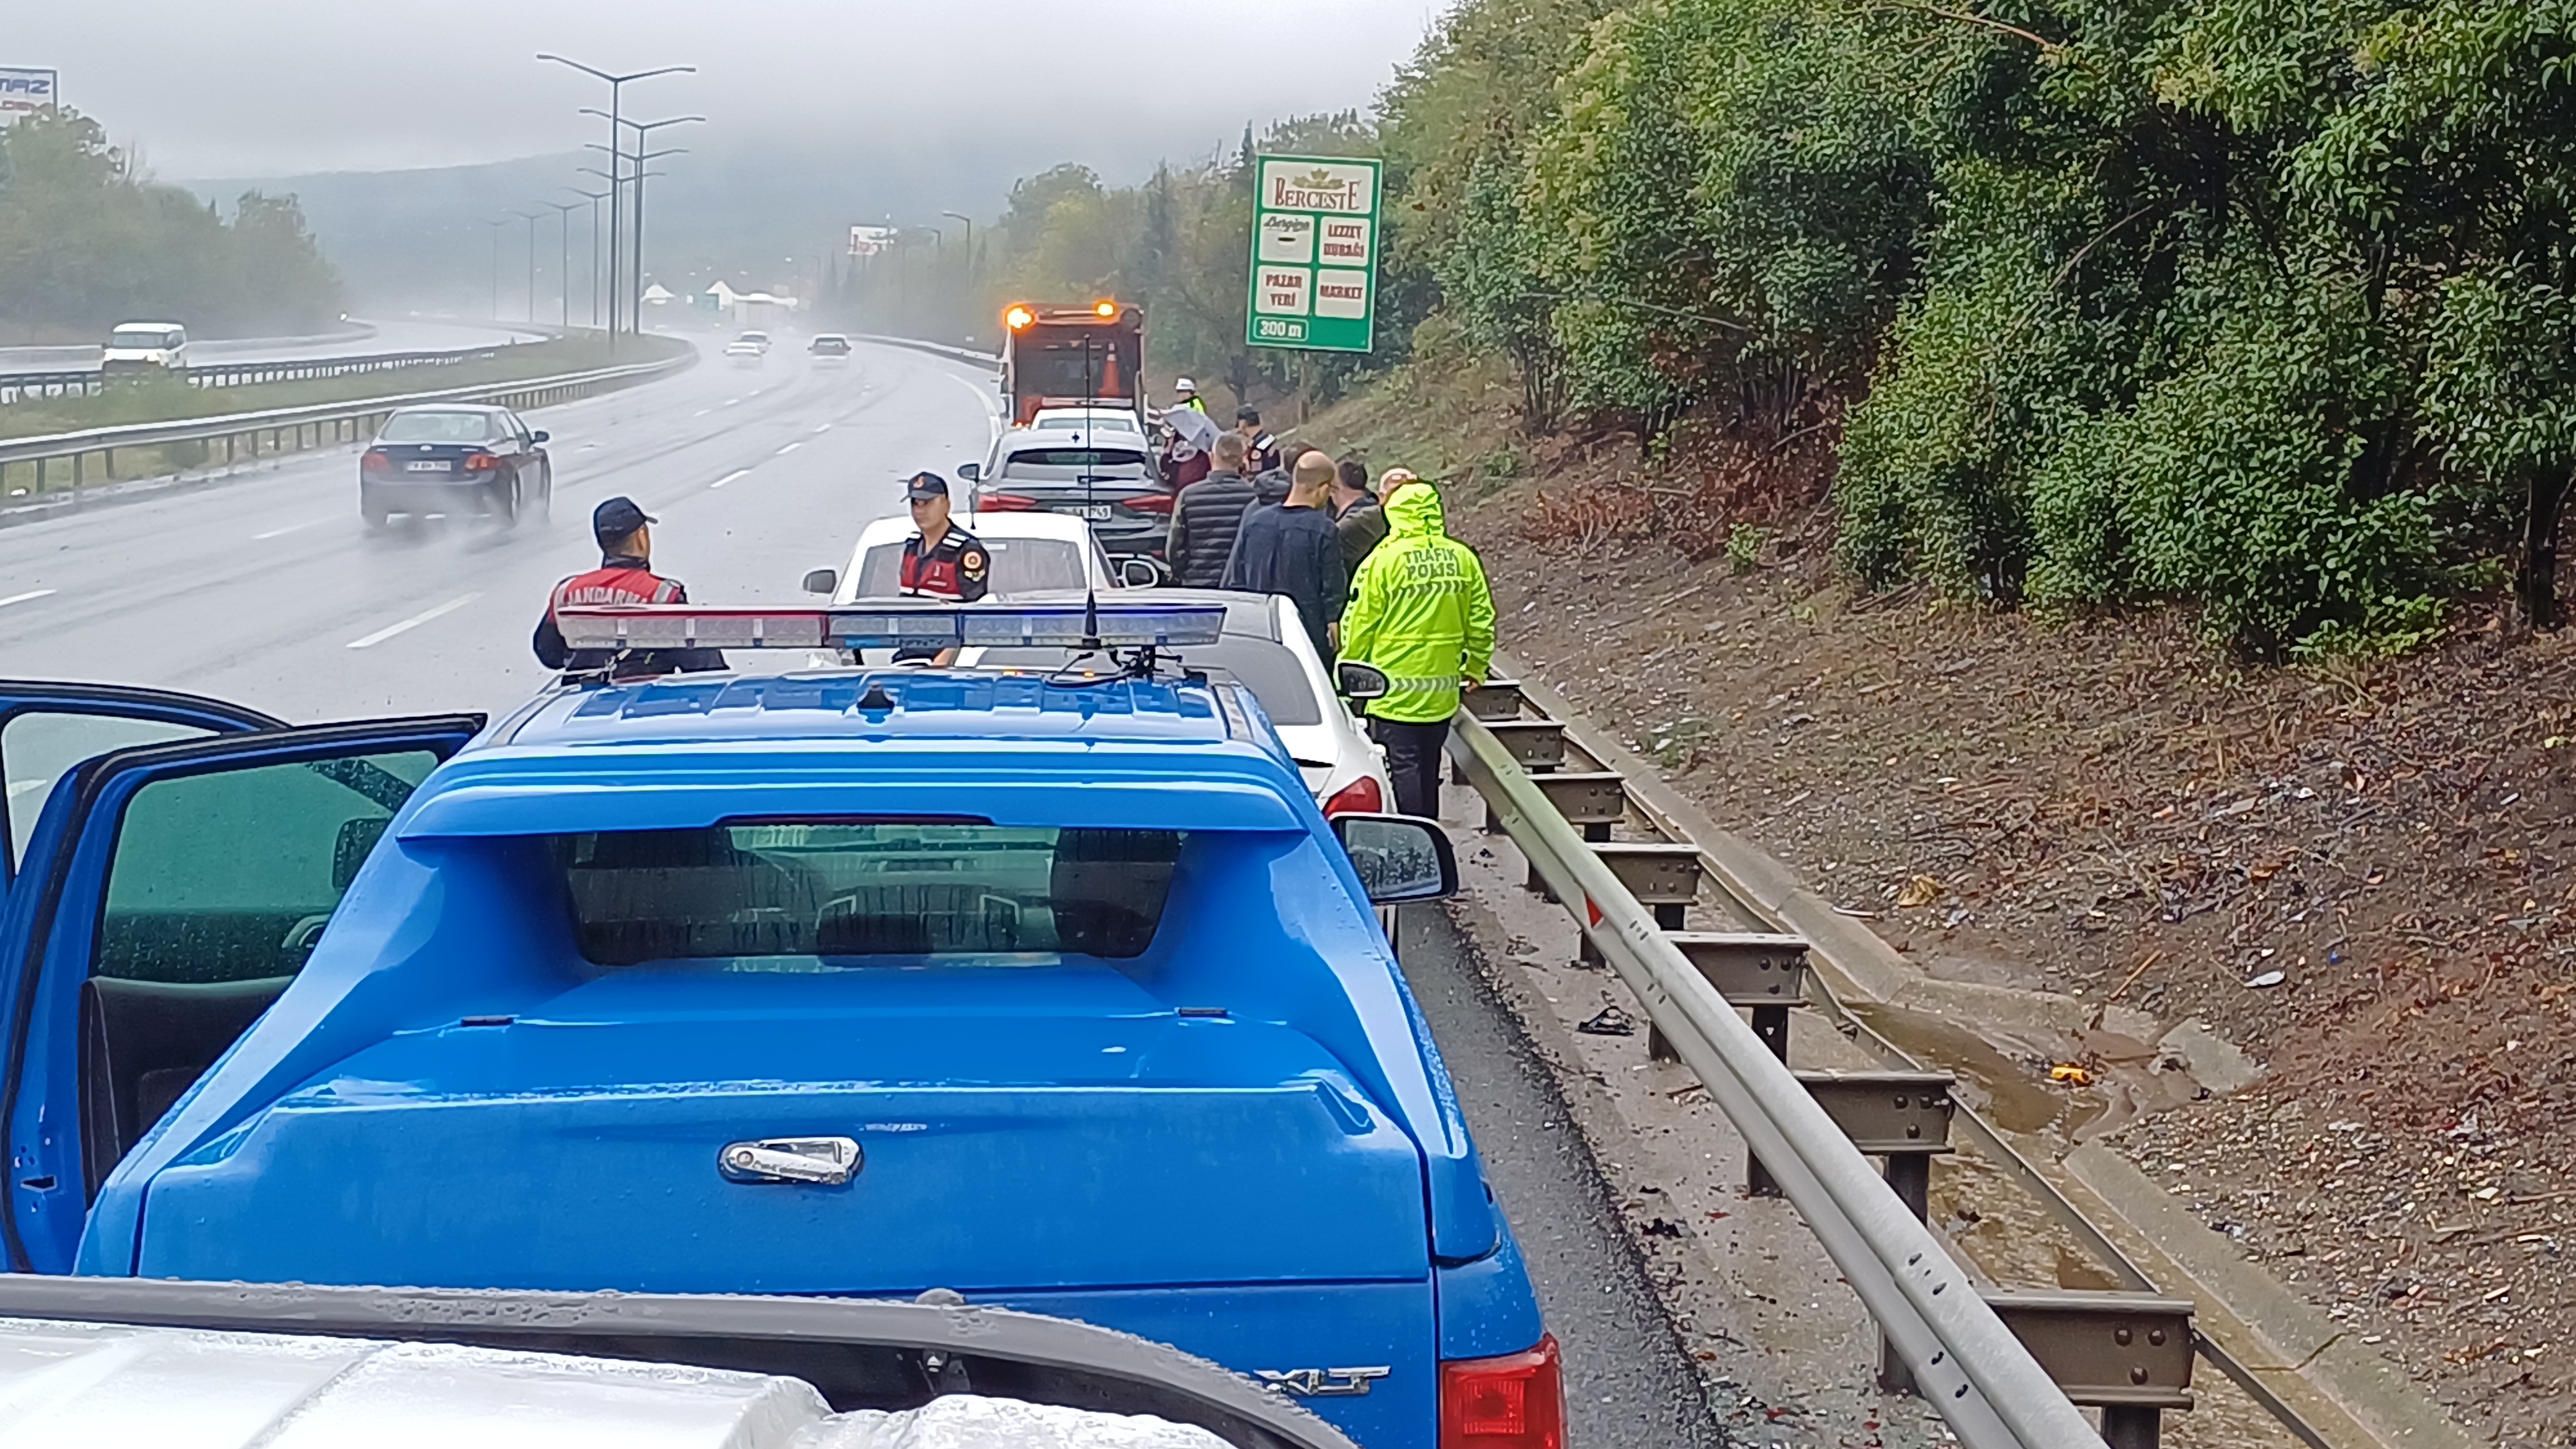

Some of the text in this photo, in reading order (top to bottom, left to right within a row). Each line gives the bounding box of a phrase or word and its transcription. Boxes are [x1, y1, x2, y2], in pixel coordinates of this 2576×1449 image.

[1274, 177, 1361, 210] BERCESTE
[1320, 285, 1363, 299] MARKET
[1260, 320, 1302, 337] 300 m
[1253, 1365, 1391, 1396] XLT
